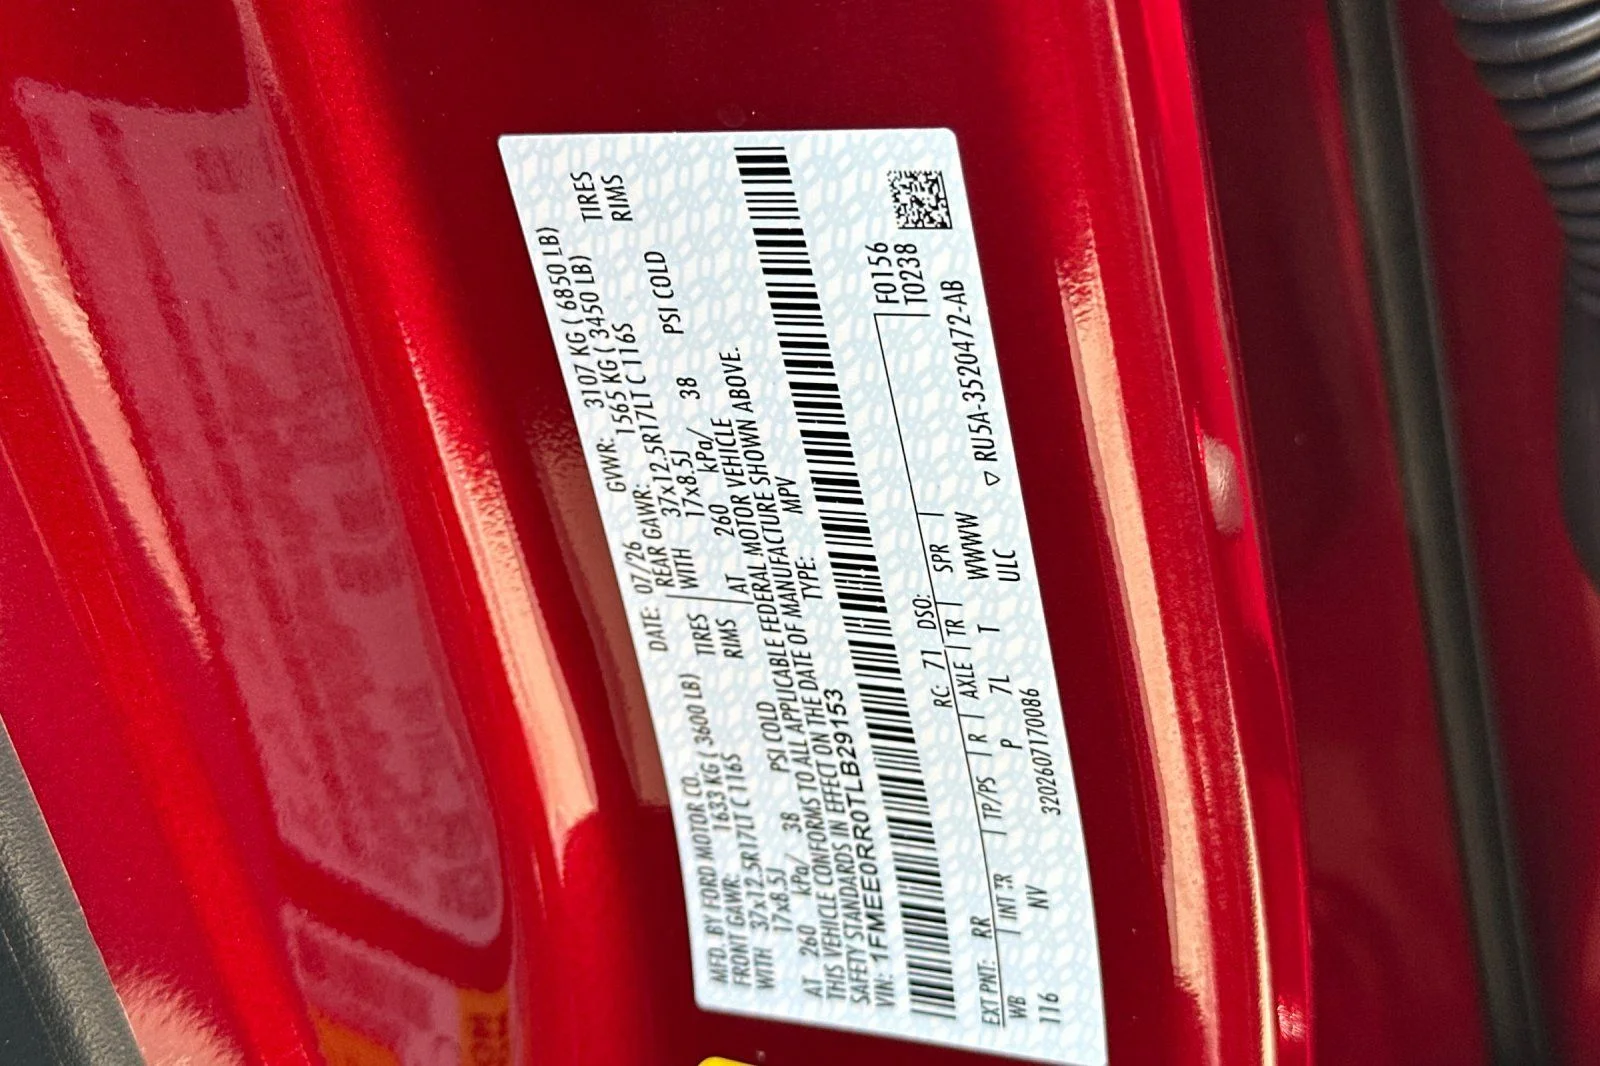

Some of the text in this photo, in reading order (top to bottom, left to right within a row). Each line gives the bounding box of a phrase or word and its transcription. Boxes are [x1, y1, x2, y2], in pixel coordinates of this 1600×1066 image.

[535, 227, 563, 256] LB)
[568, 255, 595, 284] LB)
[864, 242, 900, 304] F0156
[893, 243, 928, 306] T0238
[565, 332, 591, 357] KG
[600, 174, 706, 518] 17x8.5J RIMS
[569, 171, 700, 590] WITH 37x12.5R17LT C 116S TIRES
[573, 363, 605, 409] 3107
[596, 359, 623, 384] KG
[939, 280, 998, 462] RU5A-3520472-AB
[604, 390, 636, 435] 1565
[643, 251, 750, 595] AT 260 kPa/ 38 PSI COLD
[595, 438, 627, 493] GVWR:
[631, 484, 663, 540] GAWR:
[774, 476, 823, 601] TYPE: MPV
[928, 543, 954, 574] SPR
[954, 511, 990, 580] WWWW
[646, 546, 676, 588] REAR
[991, 548, 1021, 582] ULC
[621, 541, 669, 652] DATE: 07/26
[911, 594, 937, 630] DSO:
[944, 618, 967, 637] TR
[976, 624, 1001, 634] T
[678, 673, 703, 700] LB)
[718, 347, 871, 1005] SAFETY STANDARDS IN EFFECT ON THE DATE OF MANUFACTURE SHOWN ABOVE.
[920, 649, 953, 708] RC: 71
[952, 661, 980, 700] AXLE
[987, 674, 1013, 696] 7L
[709, 418, 847, 1001] THIS VEHICLE CONFORMS TO ALL APPLICABLE FEDERAL MOTOR VEHICLE
[967, 733, 988, 743] R
[999, 738, 1023, 750] P
[1018, 688, 1062, 816] 3202607170086
[699, 762, 723, 786] KG
[715, 618, 793, 933] 17x8.5J RIMS
[686, 613, 776, 991] WITH 37x12.5R17LT C 116S TIRES
[705, 790, 732, 831] 1633
[971, 775, 1003, 820] TP/PS
[755, 700, 823, 999] AT 260 kPa/ 38 PSI COLD
[679, 771, 729, 986] MFD. BY FORD MOTOR CO.
[721, 874, 746, 928] GAWR:
[1025, 884, 1050, 910] NV
[995, 894, 1018, 921] INT
[727, 933, 752, 988] FRONT
[969, 916, 1003, 1028] EXT PNT: RR
[874, 973, 896, 1008] VIN:
[1006, 995, 1028, 1019] WB
[1037, 992, 1061, 1025] 116
